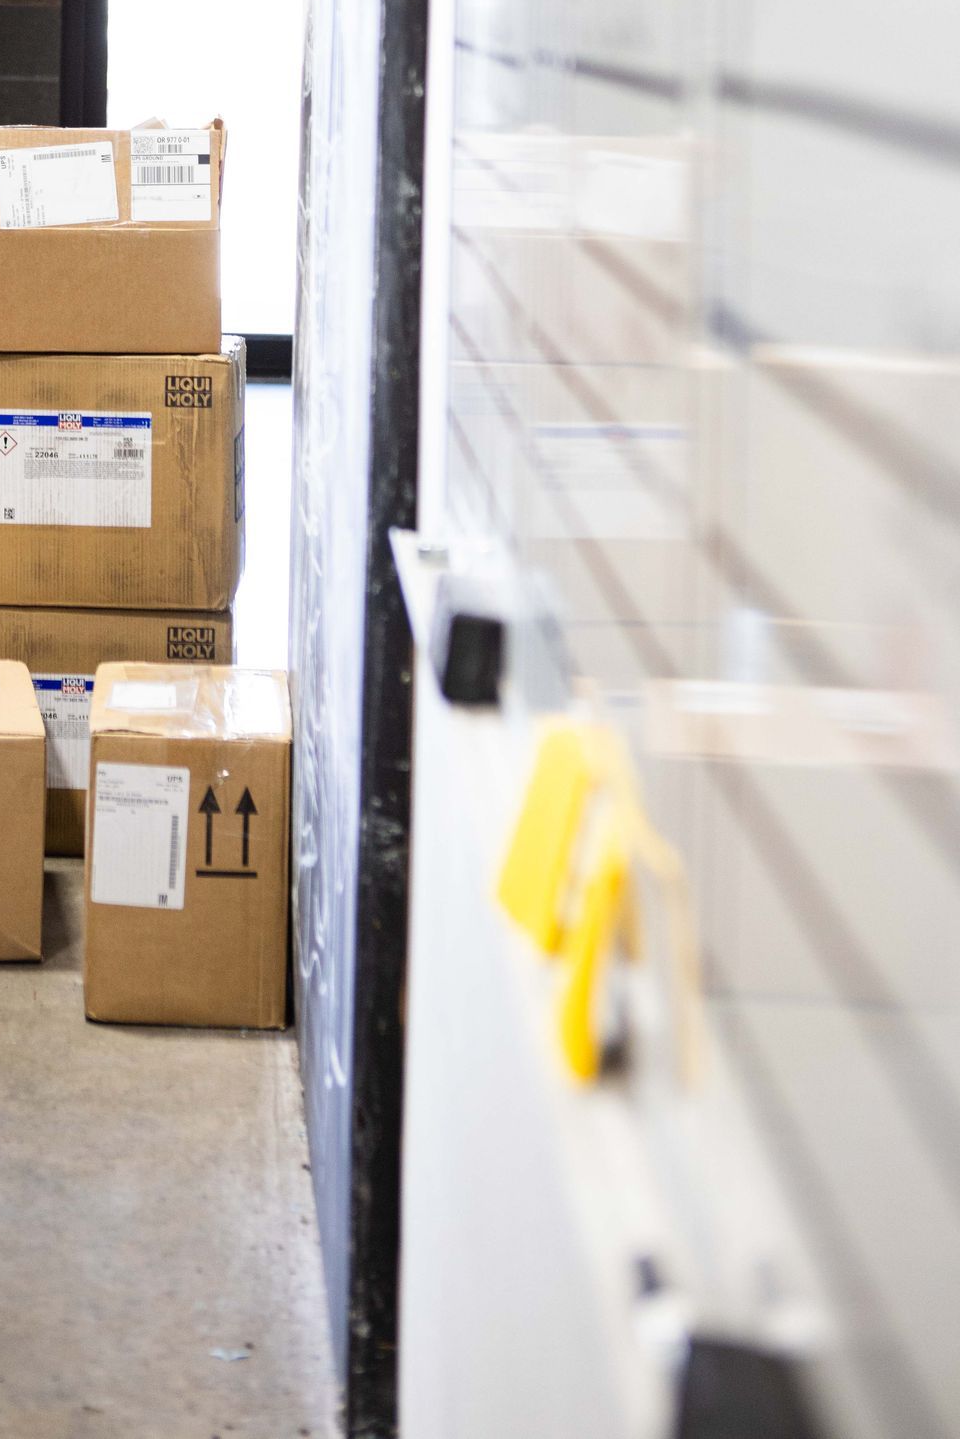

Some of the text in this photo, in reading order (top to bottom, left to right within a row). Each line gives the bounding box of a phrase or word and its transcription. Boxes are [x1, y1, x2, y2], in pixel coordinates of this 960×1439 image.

[167, 376, 210, 391] LIQUI
[167, 393, 211, 408] MOLY
[59, 414, 82, 422] LIQUI
[59, 422, 82, 430] MOLY
[168, 628, 214, 643] LIQUI
[168, 644, 214, 659] MOLY
[63, 678, 85, 686] LIQUI
